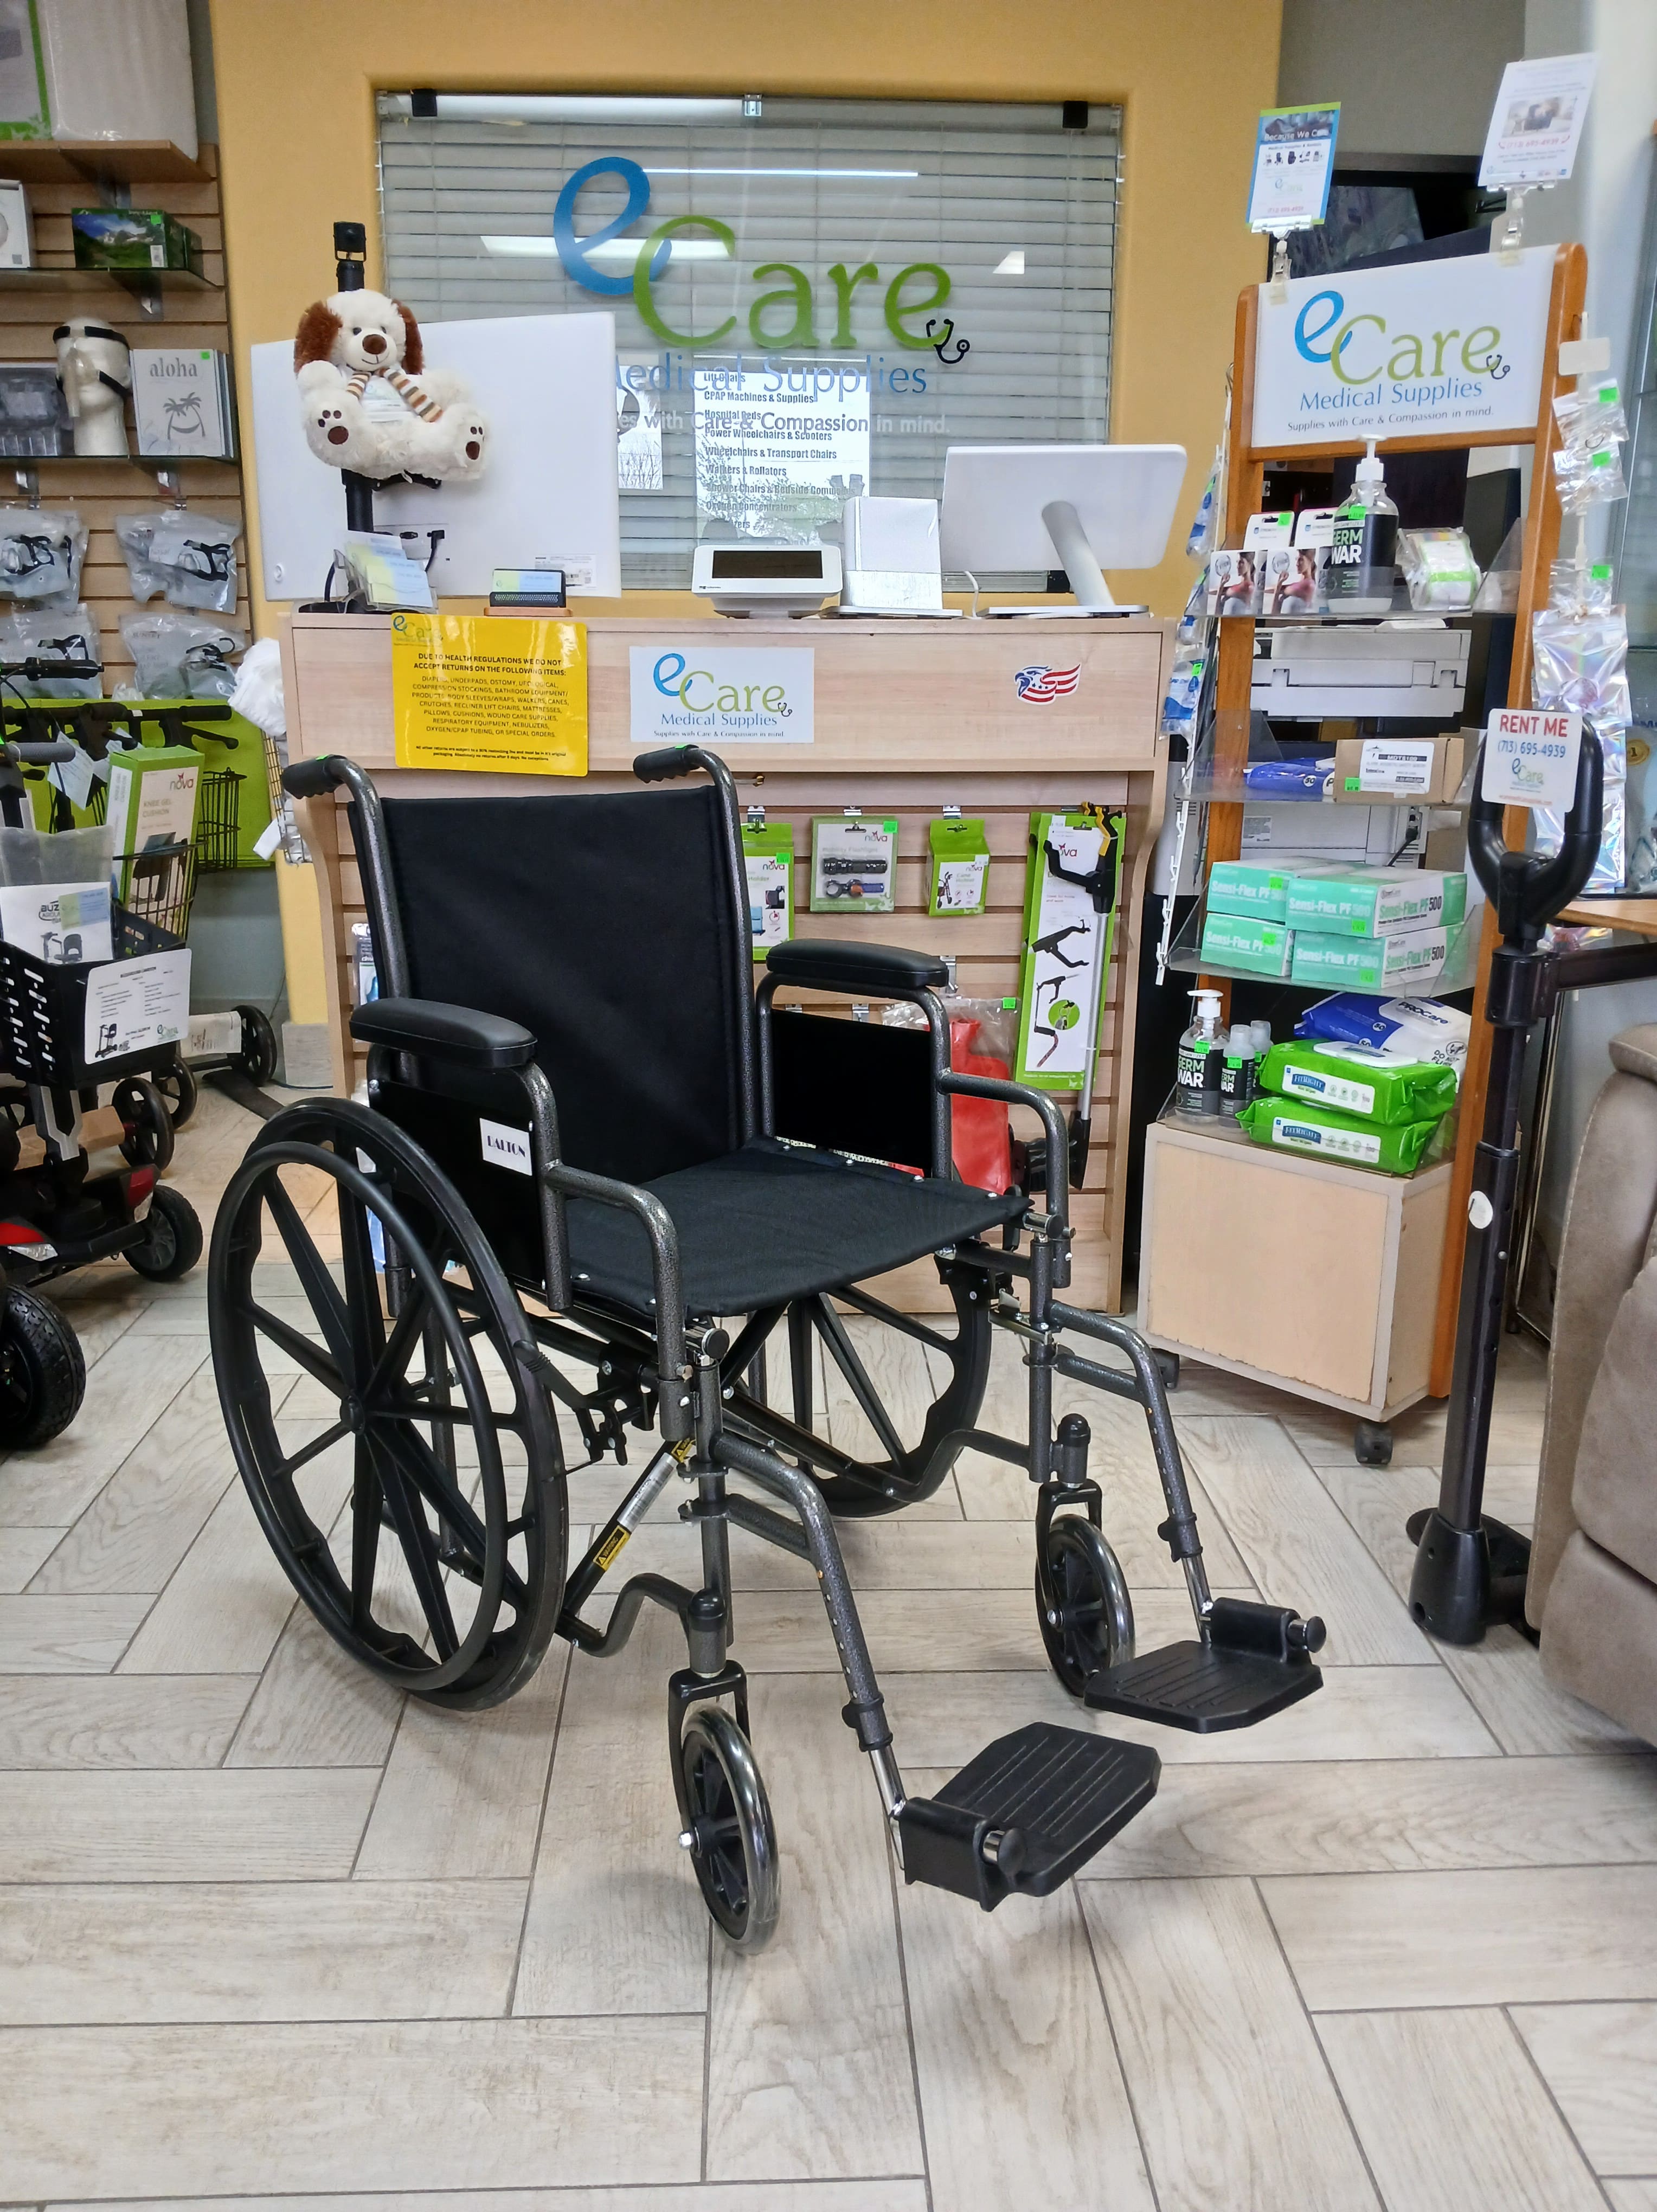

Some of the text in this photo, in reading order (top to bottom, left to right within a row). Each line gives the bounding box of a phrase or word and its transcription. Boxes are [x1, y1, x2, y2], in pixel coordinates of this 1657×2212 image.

[554, 157, 952, 348] eCare
[1294, 290, 1501, 385] eCare
[150, 357, 198, 377] aloha
[763, 355, 927, 403] Supplies
[704, 391, 814, 404] CPAP Machines & Supplies
[1300, 377, 1482, 411] Medical Supplies
[644, 410, 683, 430] with
[691, 411, 733, 430] Care
[761, 411, 869, 434] Compassion
[876, 414, 892, 433] in
[900, 414, 950, 434] mind.
[1288, 406, 1494, 433] Supplies with Care & Compassion in mind.
[733, 428, 786, 440] Wheelchairs
[787, 431, 793, 440] &
[795, 430, 832, 441] Scooters
[760, 449, 766, 458] &
[767, 448, 809, 459] Transport
[810, 449, 837, 460] Chairs
[749, 466, 787, 477] Rollators
[474, 656, 522, 664] REGULATIONS
[519, 680, 559, 689] UROOGICAL,
[653, 653, 785, 713] eCare
[661, 712, 778, 729] Medical Supplies
[1500, 714, 1569, 737] RENT ME
[1498, 740, 1566, 758] (713) 695-4939
[1512, 758, 1544, 783] eCare
[170, 777, 194, 790] nova
[865, 834, 888, 842] nova
[1059, 848, 1077, 857] va
[762, 862, 785, 870] nova
[1211, 879, 1257, 898] Sensi-Flex
[41, 904, 60, 912] BUZ
[1289, 897, 1337, 914] Sensi-Flex
[1379, 901, 1418, 919] Sensi-Flex
[1205, 930, 1250, 950] Sensi-Flex
[1296, 948, 1345, 965] Sensi-Flex
[1374, 1023, 1386, 1031] 50
[1434, 1050, 1446, 1059] DO
[1177, 1068, 1204, 1088] WAR
[1221, 1072, 1235, 1084] ERM
[487, 1135, 525, 1158] DALTON
